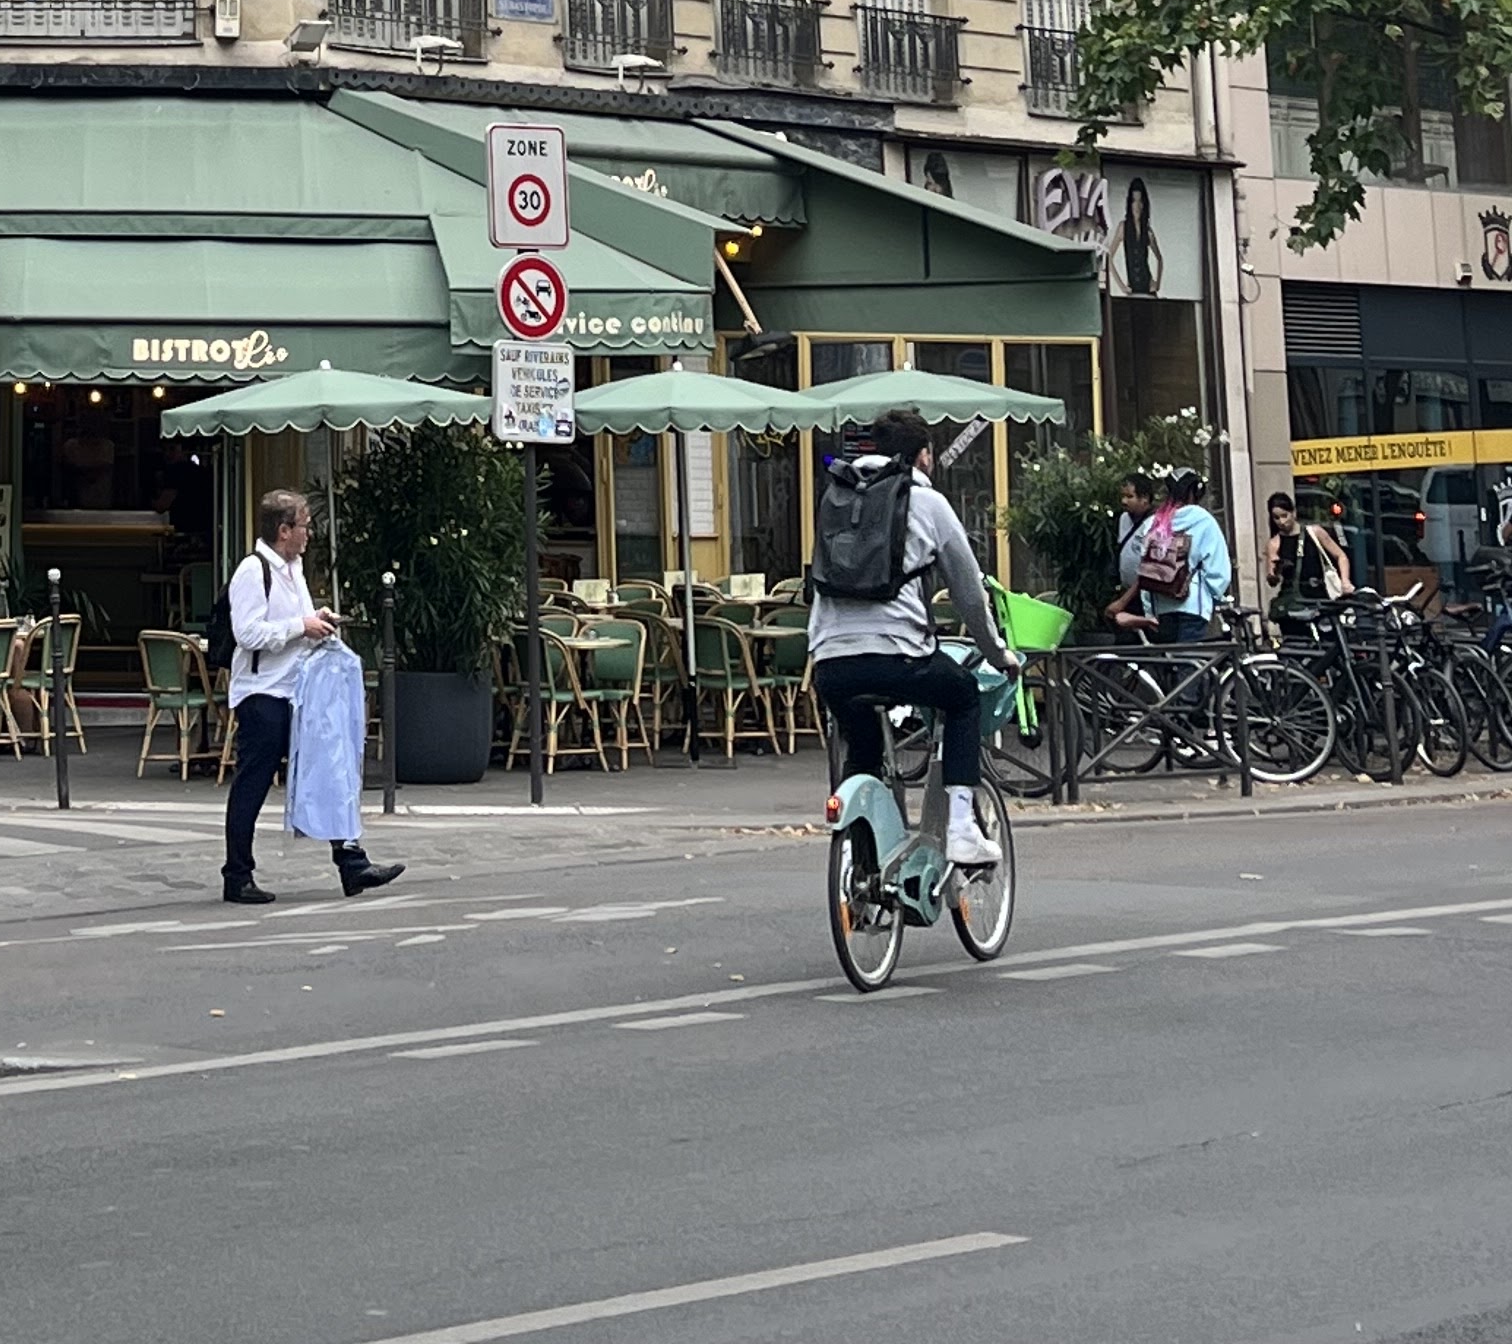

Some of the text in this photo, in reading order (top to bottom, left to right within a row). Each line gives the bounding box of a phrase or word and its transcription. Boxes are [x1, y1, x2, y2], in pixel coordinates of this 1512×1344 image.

[507, 139, 548, 157] ZONE
[518, 190, 541, 211] 30
[631, 310, 705, 335] continu
[132, 338, 248, 363] BISTROT
[500, 348, 569, 365] SAUF RIVERAINS
[511, 384, 559, 400] DE SERVICE
[515, 401, 541, 416] TAXIS
[1292, 447, 1333, 466] VENEZ
[1335, 444, 1379, 464] MENER
[1381, 437, 1446, 460] L'ENQUÊTE
